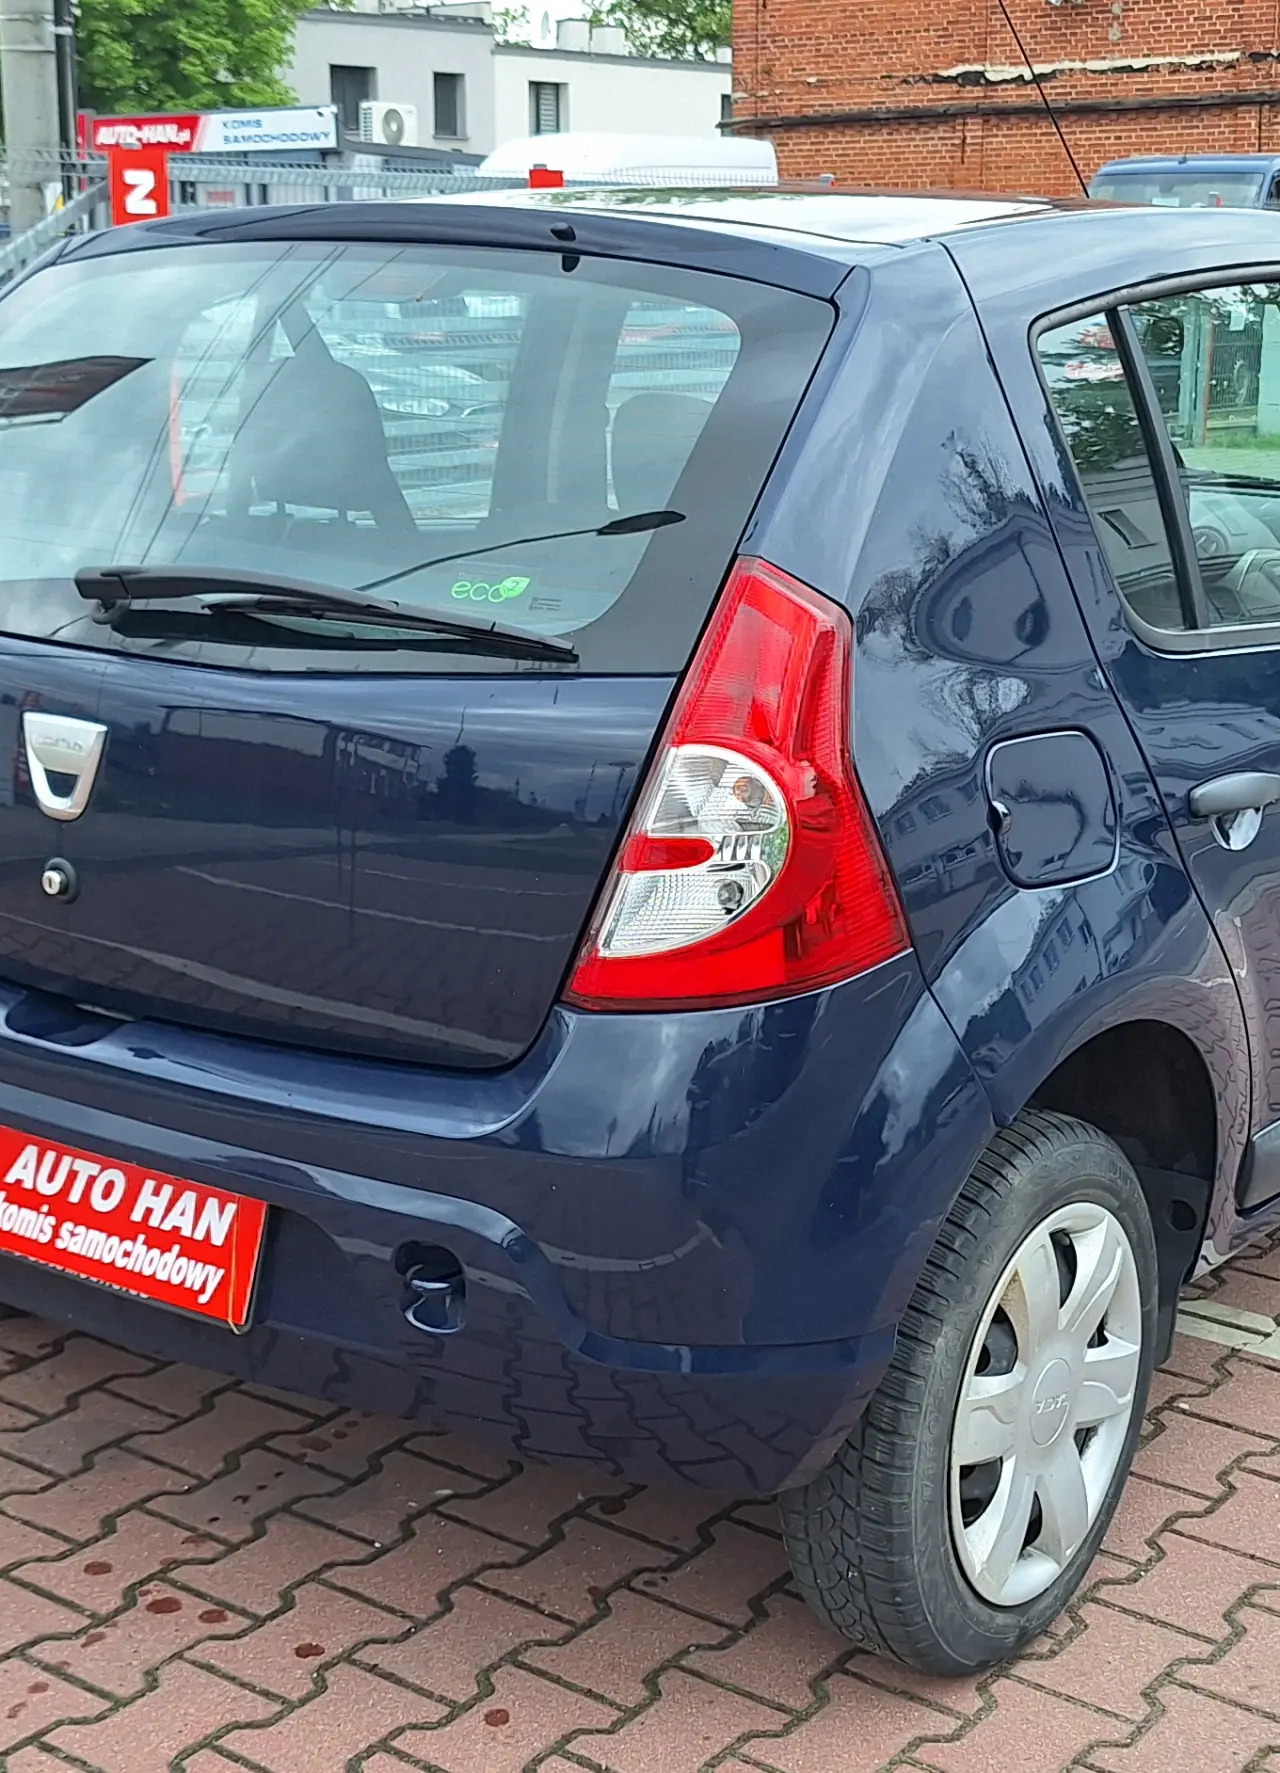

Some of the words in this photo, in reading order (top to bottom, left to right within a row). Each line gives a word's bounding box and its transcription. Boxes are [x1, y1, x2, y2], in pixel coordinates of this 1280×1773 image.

[222, 119, 262, 129] KOMIS
[223, 131, 331, 145] SAMOCHODOWY
[5, 1143, 126, 1213] AUTO
[130, 1178, 238, 1247] HAN
[54, 1219, 225, 1305] samochodowy
